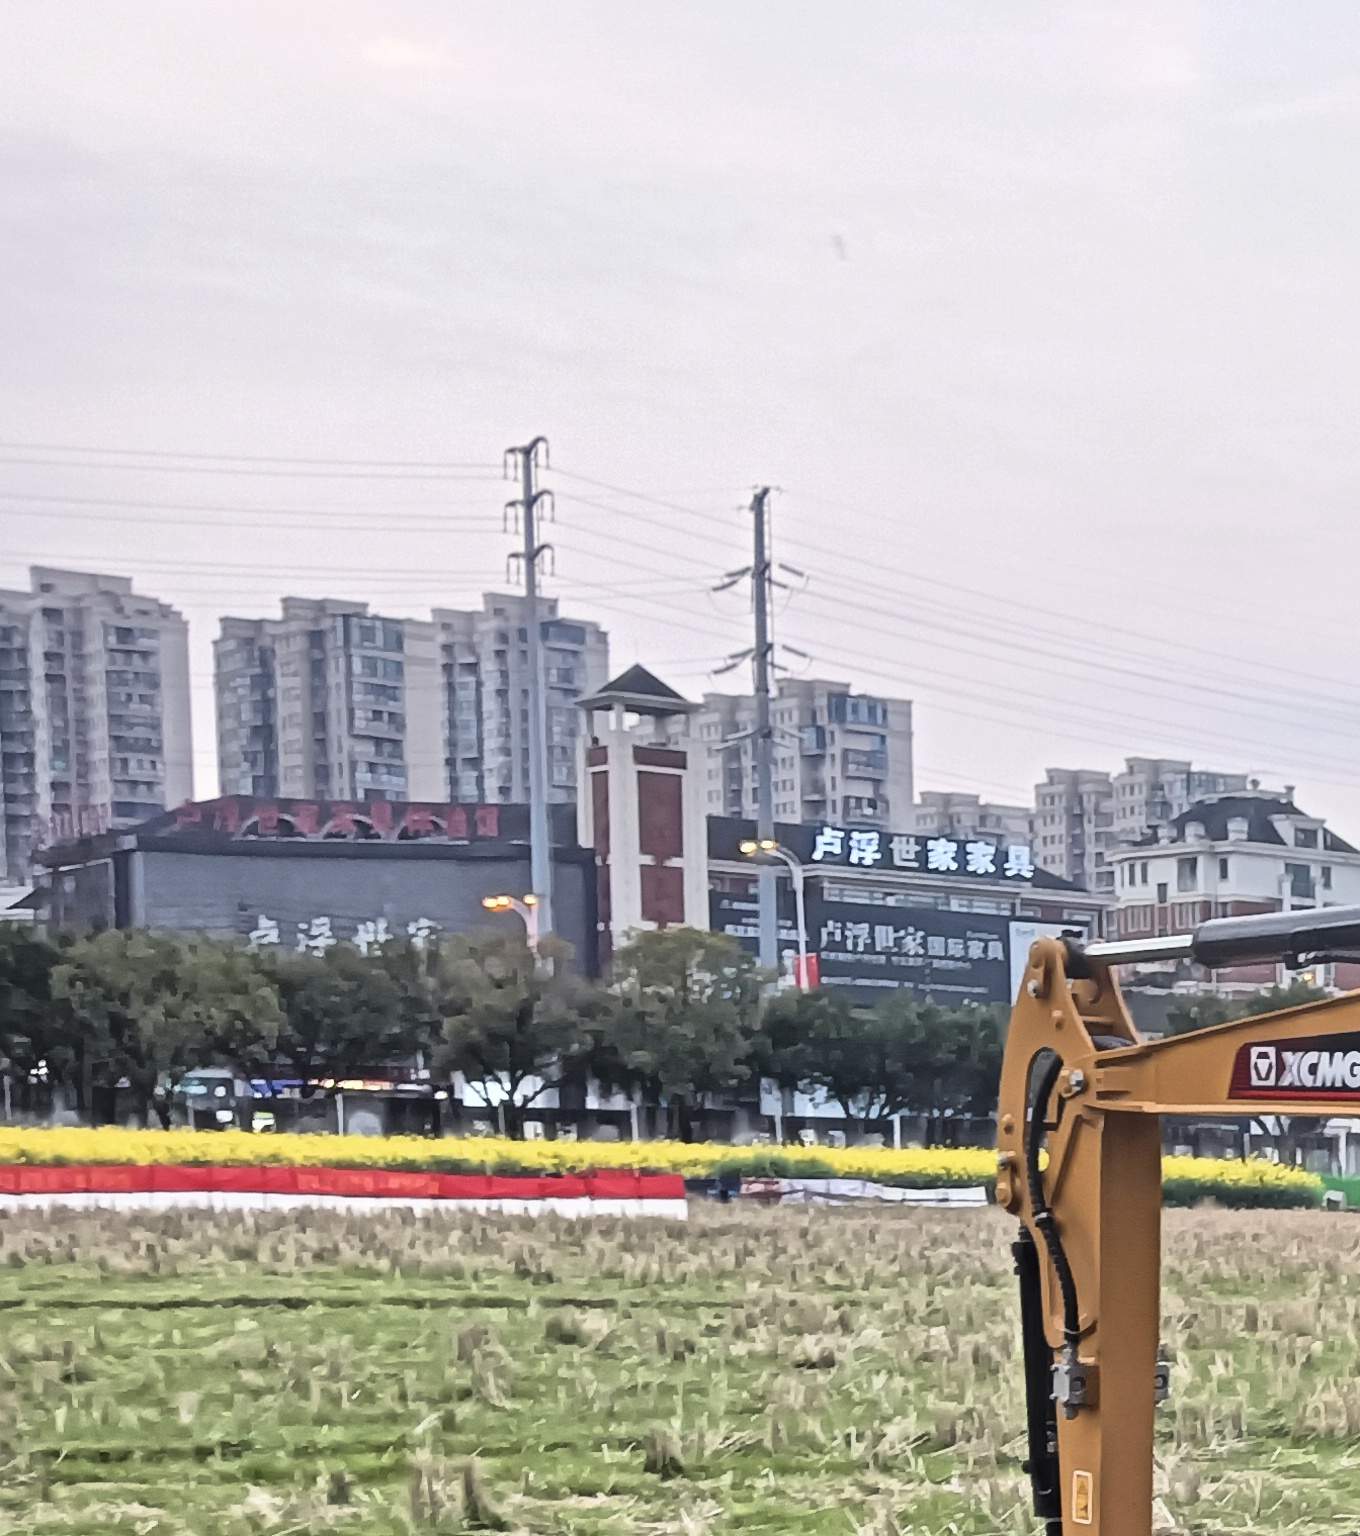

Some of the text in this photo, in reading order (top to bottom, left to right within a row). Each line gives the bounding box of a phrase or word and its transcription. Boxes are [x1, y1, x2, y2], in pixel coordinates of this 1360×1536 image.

[812, 826, 1035, 879] 卢浮世家家具
